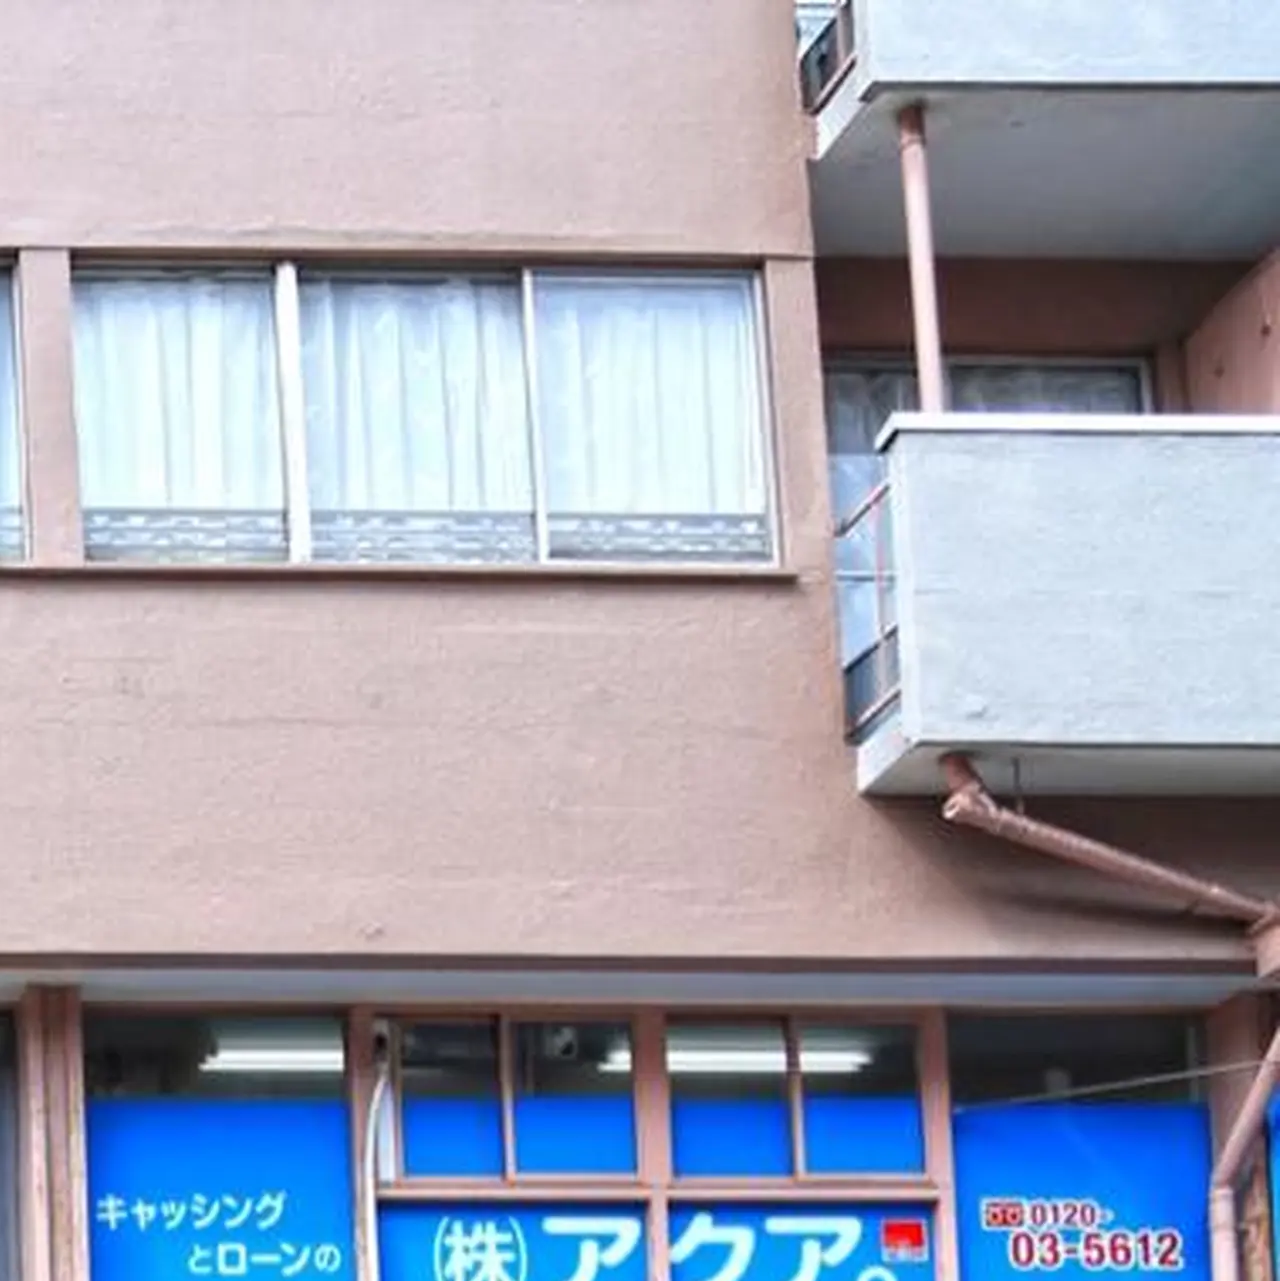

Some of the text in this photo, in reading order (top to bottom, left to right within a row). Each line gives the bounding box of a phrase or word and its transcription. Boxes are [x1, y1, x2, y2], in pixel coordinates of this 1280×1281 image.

[96, 1192, 287, 1229] キャッシング
[187, 1243, 341, 1276] とローンの
[1011, 1231, 1180, 1268] 03-5612
